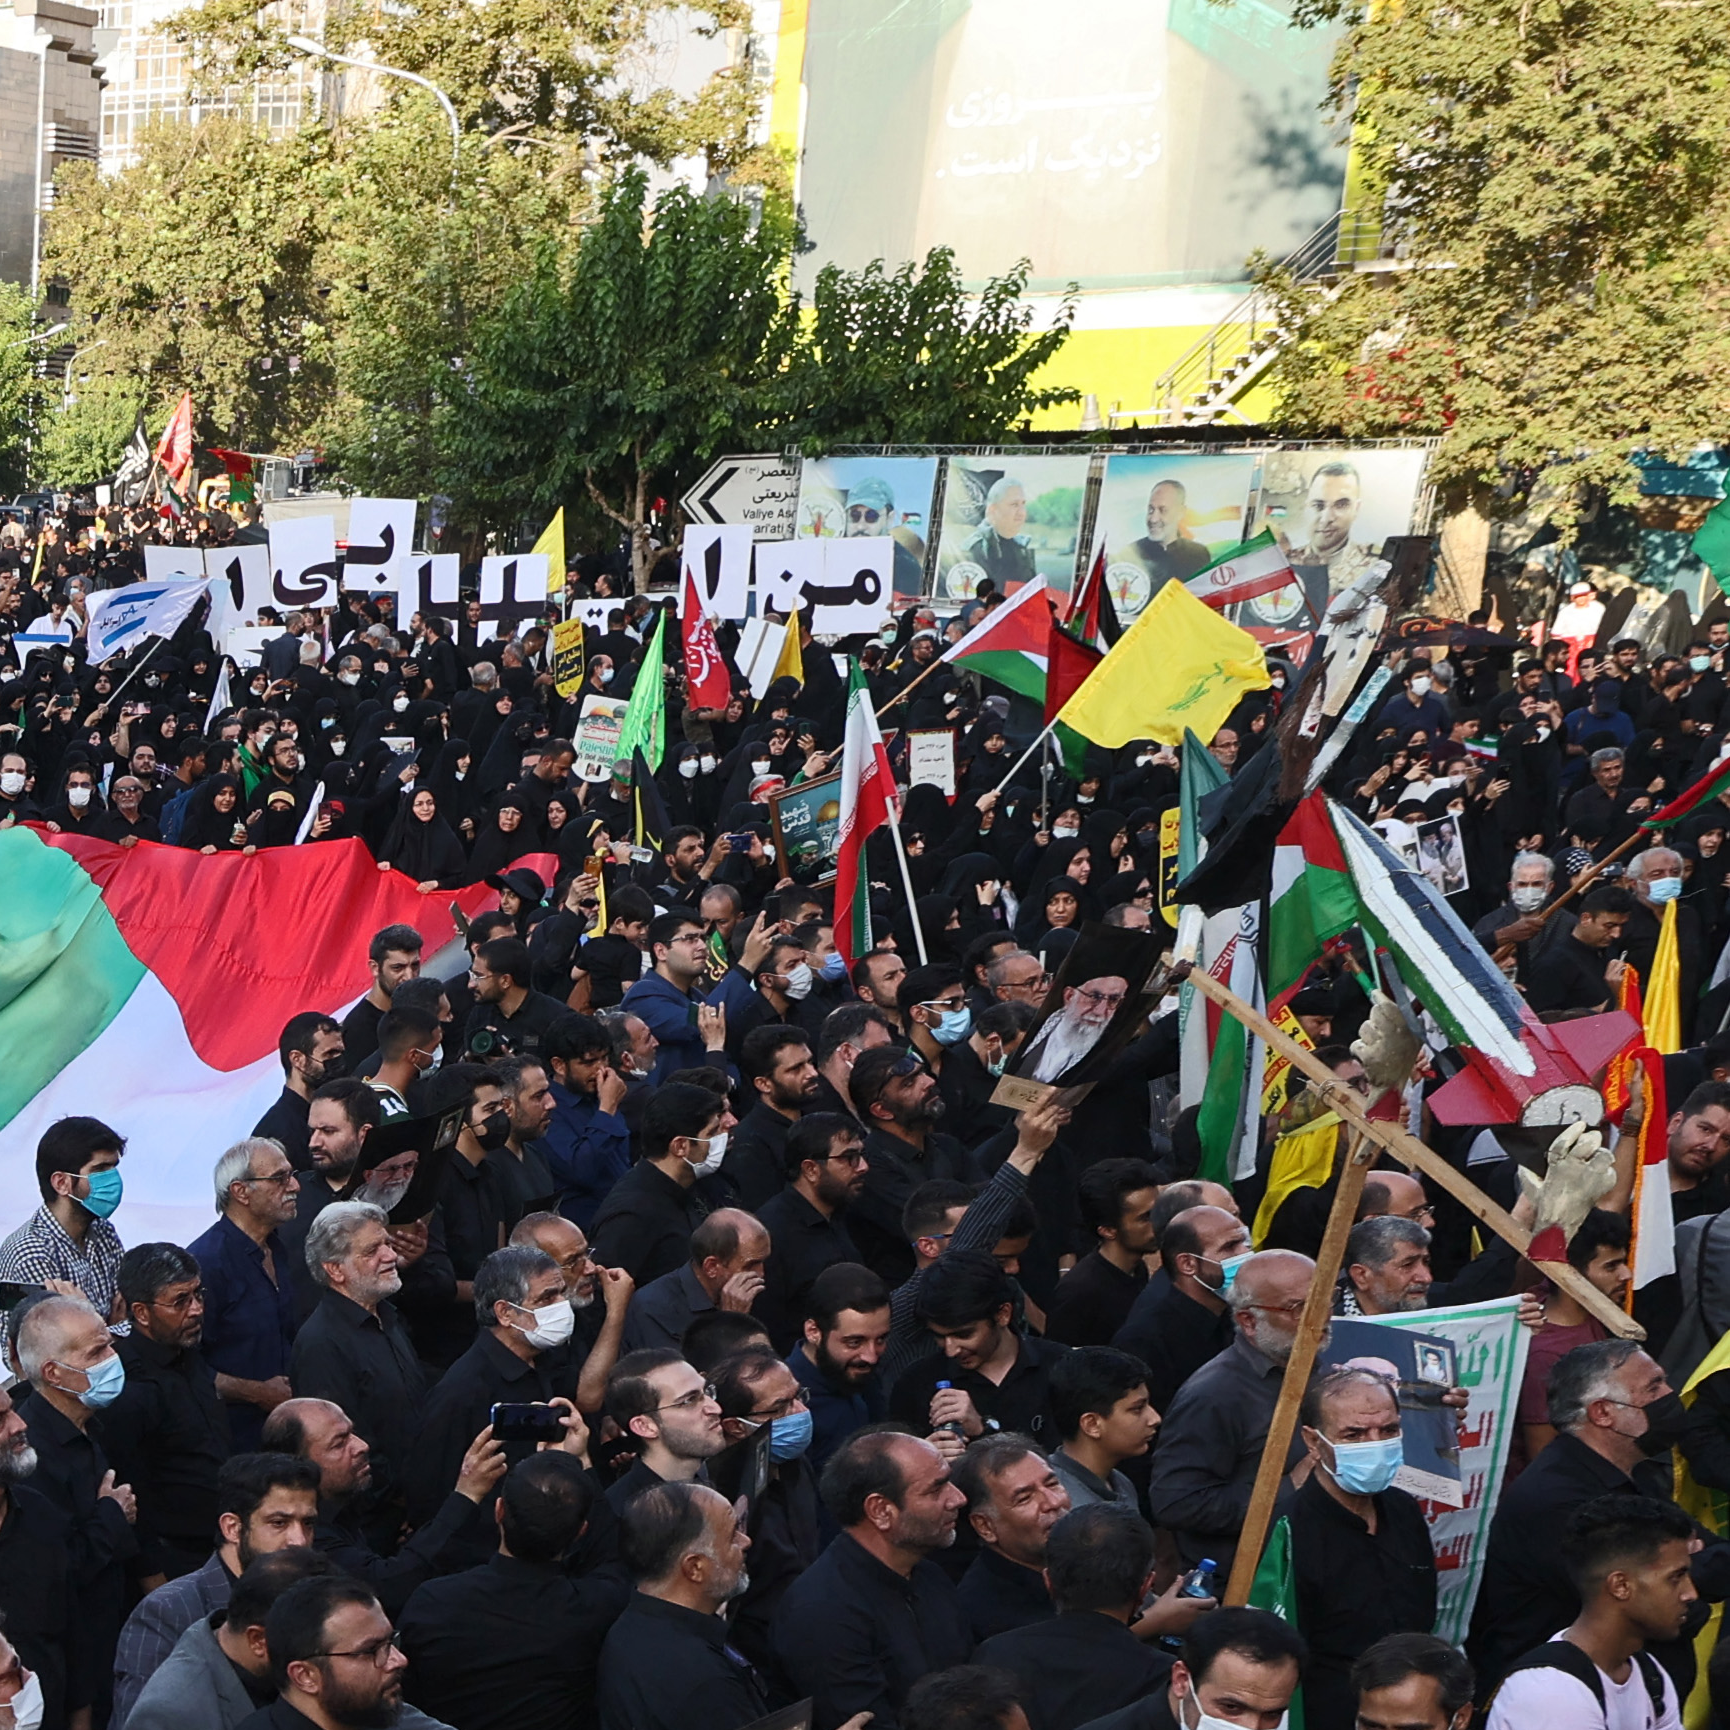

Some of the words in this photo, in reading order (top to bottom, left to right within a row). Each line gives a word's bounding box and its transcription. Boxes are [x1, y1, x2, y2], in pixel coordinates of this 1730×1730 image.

[945, 79, 1163, 129] پیروزی
[1044, 131, 1162, 181] نزدیک
[743, 508, 774, 521] Valiye
[777, 508, 797, 519] Asr
[754, 523, 784, 534] ari'ati
[579, 741, 615, 755] Palestin
[780, 799, 810, 820] شهید
[781, 813, 812, 833] قدس
